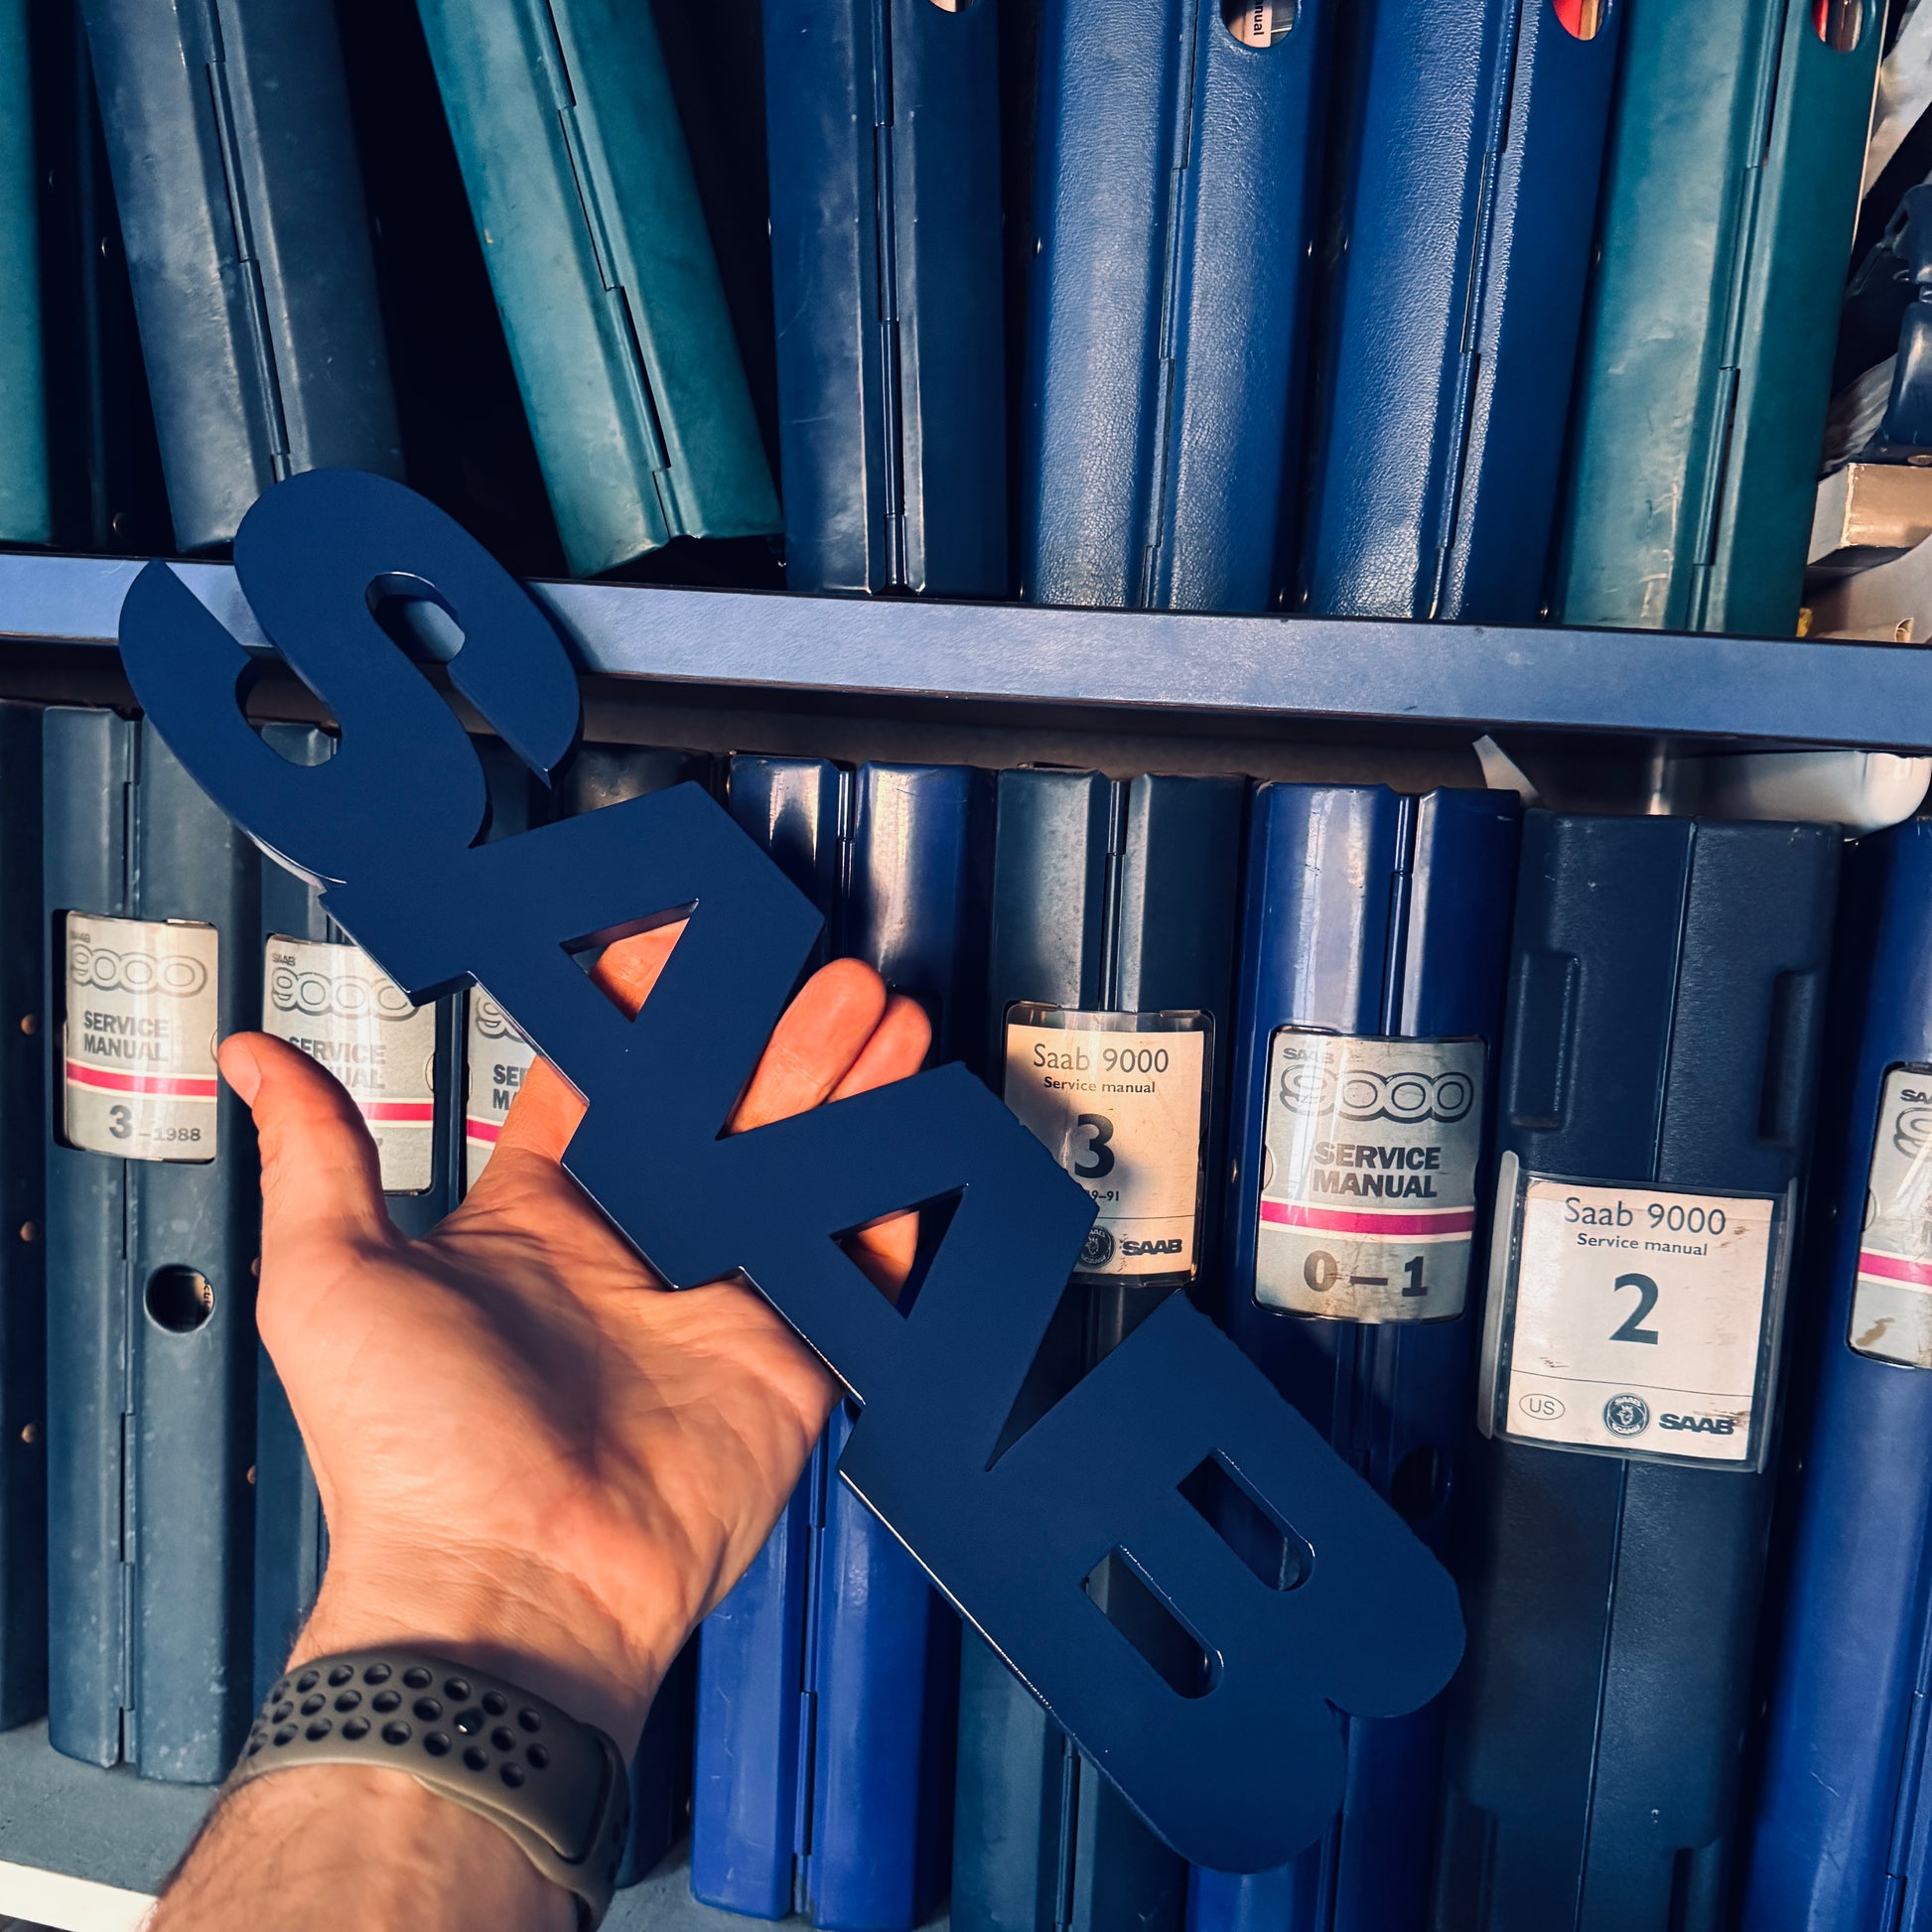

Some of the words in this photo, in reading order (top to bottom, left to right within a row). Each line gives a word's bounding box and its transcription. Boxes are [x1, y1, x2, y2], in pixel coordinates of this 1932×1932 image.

[70, 943, 207, 998] 9000
[83, 1011, 170, 1038] SERVICE
[83, 1034, 169, 1061] MANUAL
[1034, 1043, 1090, 1071] Saab
[1103, 1048, 1169, 1073] 9000
[1043, 1076, 1097, 1092] Service
[1102, 1081, 1156, 1093] manual
[1280, 1064, 1474, 1124] 9000
[1074, 1114, 1115, 1178] 3
[1313, 1143, 1442, 1171] SERVICE
[119, 469, 1466, 1873] SAAB
[1312, 1170, 1438, 1198] MANUAL
[1565, 1196, 1633, 1227] Saab
[1647, 1203, 1725, 1235] 9000
[1122, 1239, 1182, 1256] SAAB
[1577, 1232, 1639, 1250] Service
[1644, 1241, 1708, 1256] manual
[1608, 1273, 1659, 1345] 2
[1529, 1398, 1556, 1417] US
[1659, 1413, 1735, 1436] SAAB
